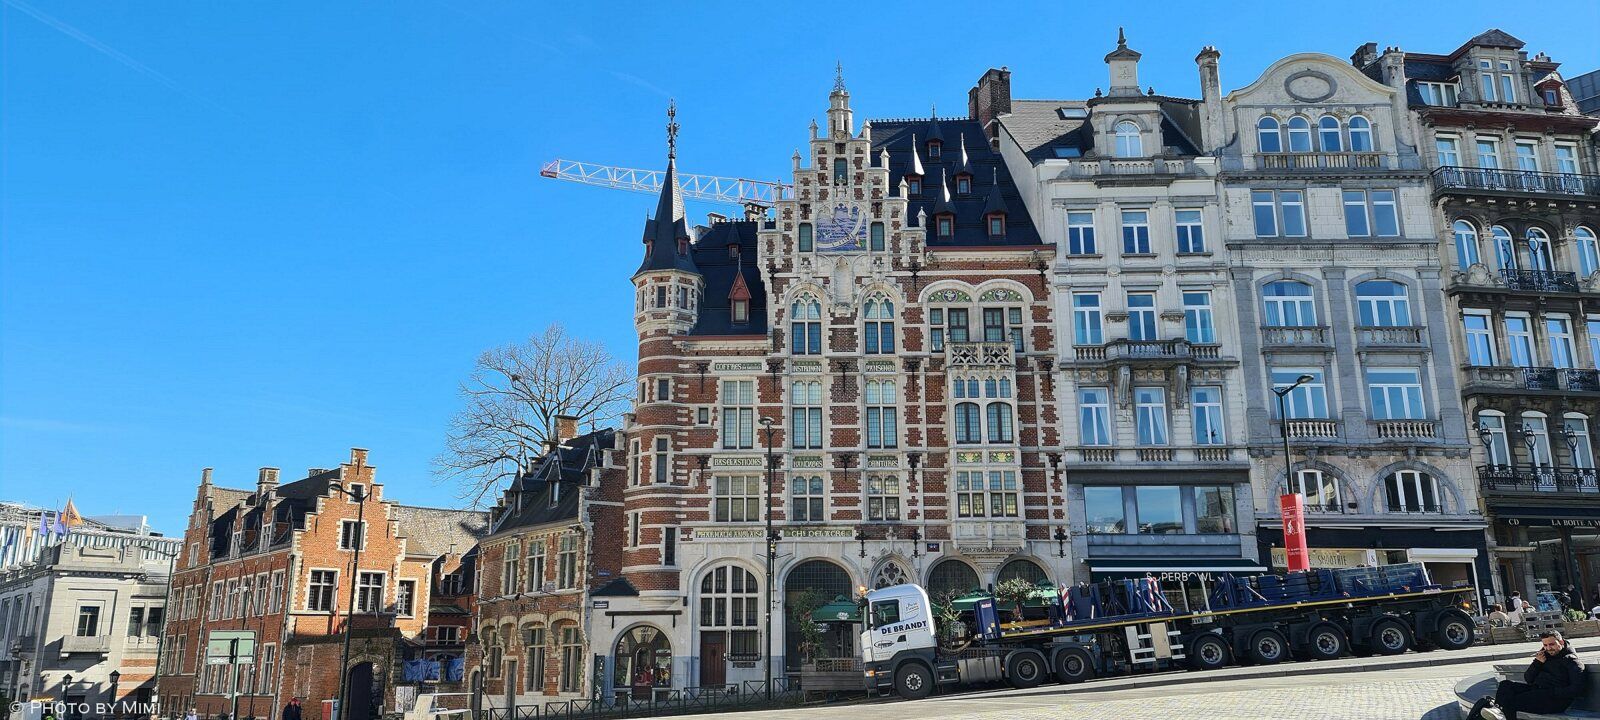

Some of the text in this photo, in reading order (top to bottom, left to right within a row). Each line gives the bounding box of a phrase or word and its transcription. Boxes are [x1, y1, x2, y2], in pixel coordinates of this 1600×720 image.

[1508, 518, 1520, 526] CD
[881, 620, 927, 635] DE BRANDT
